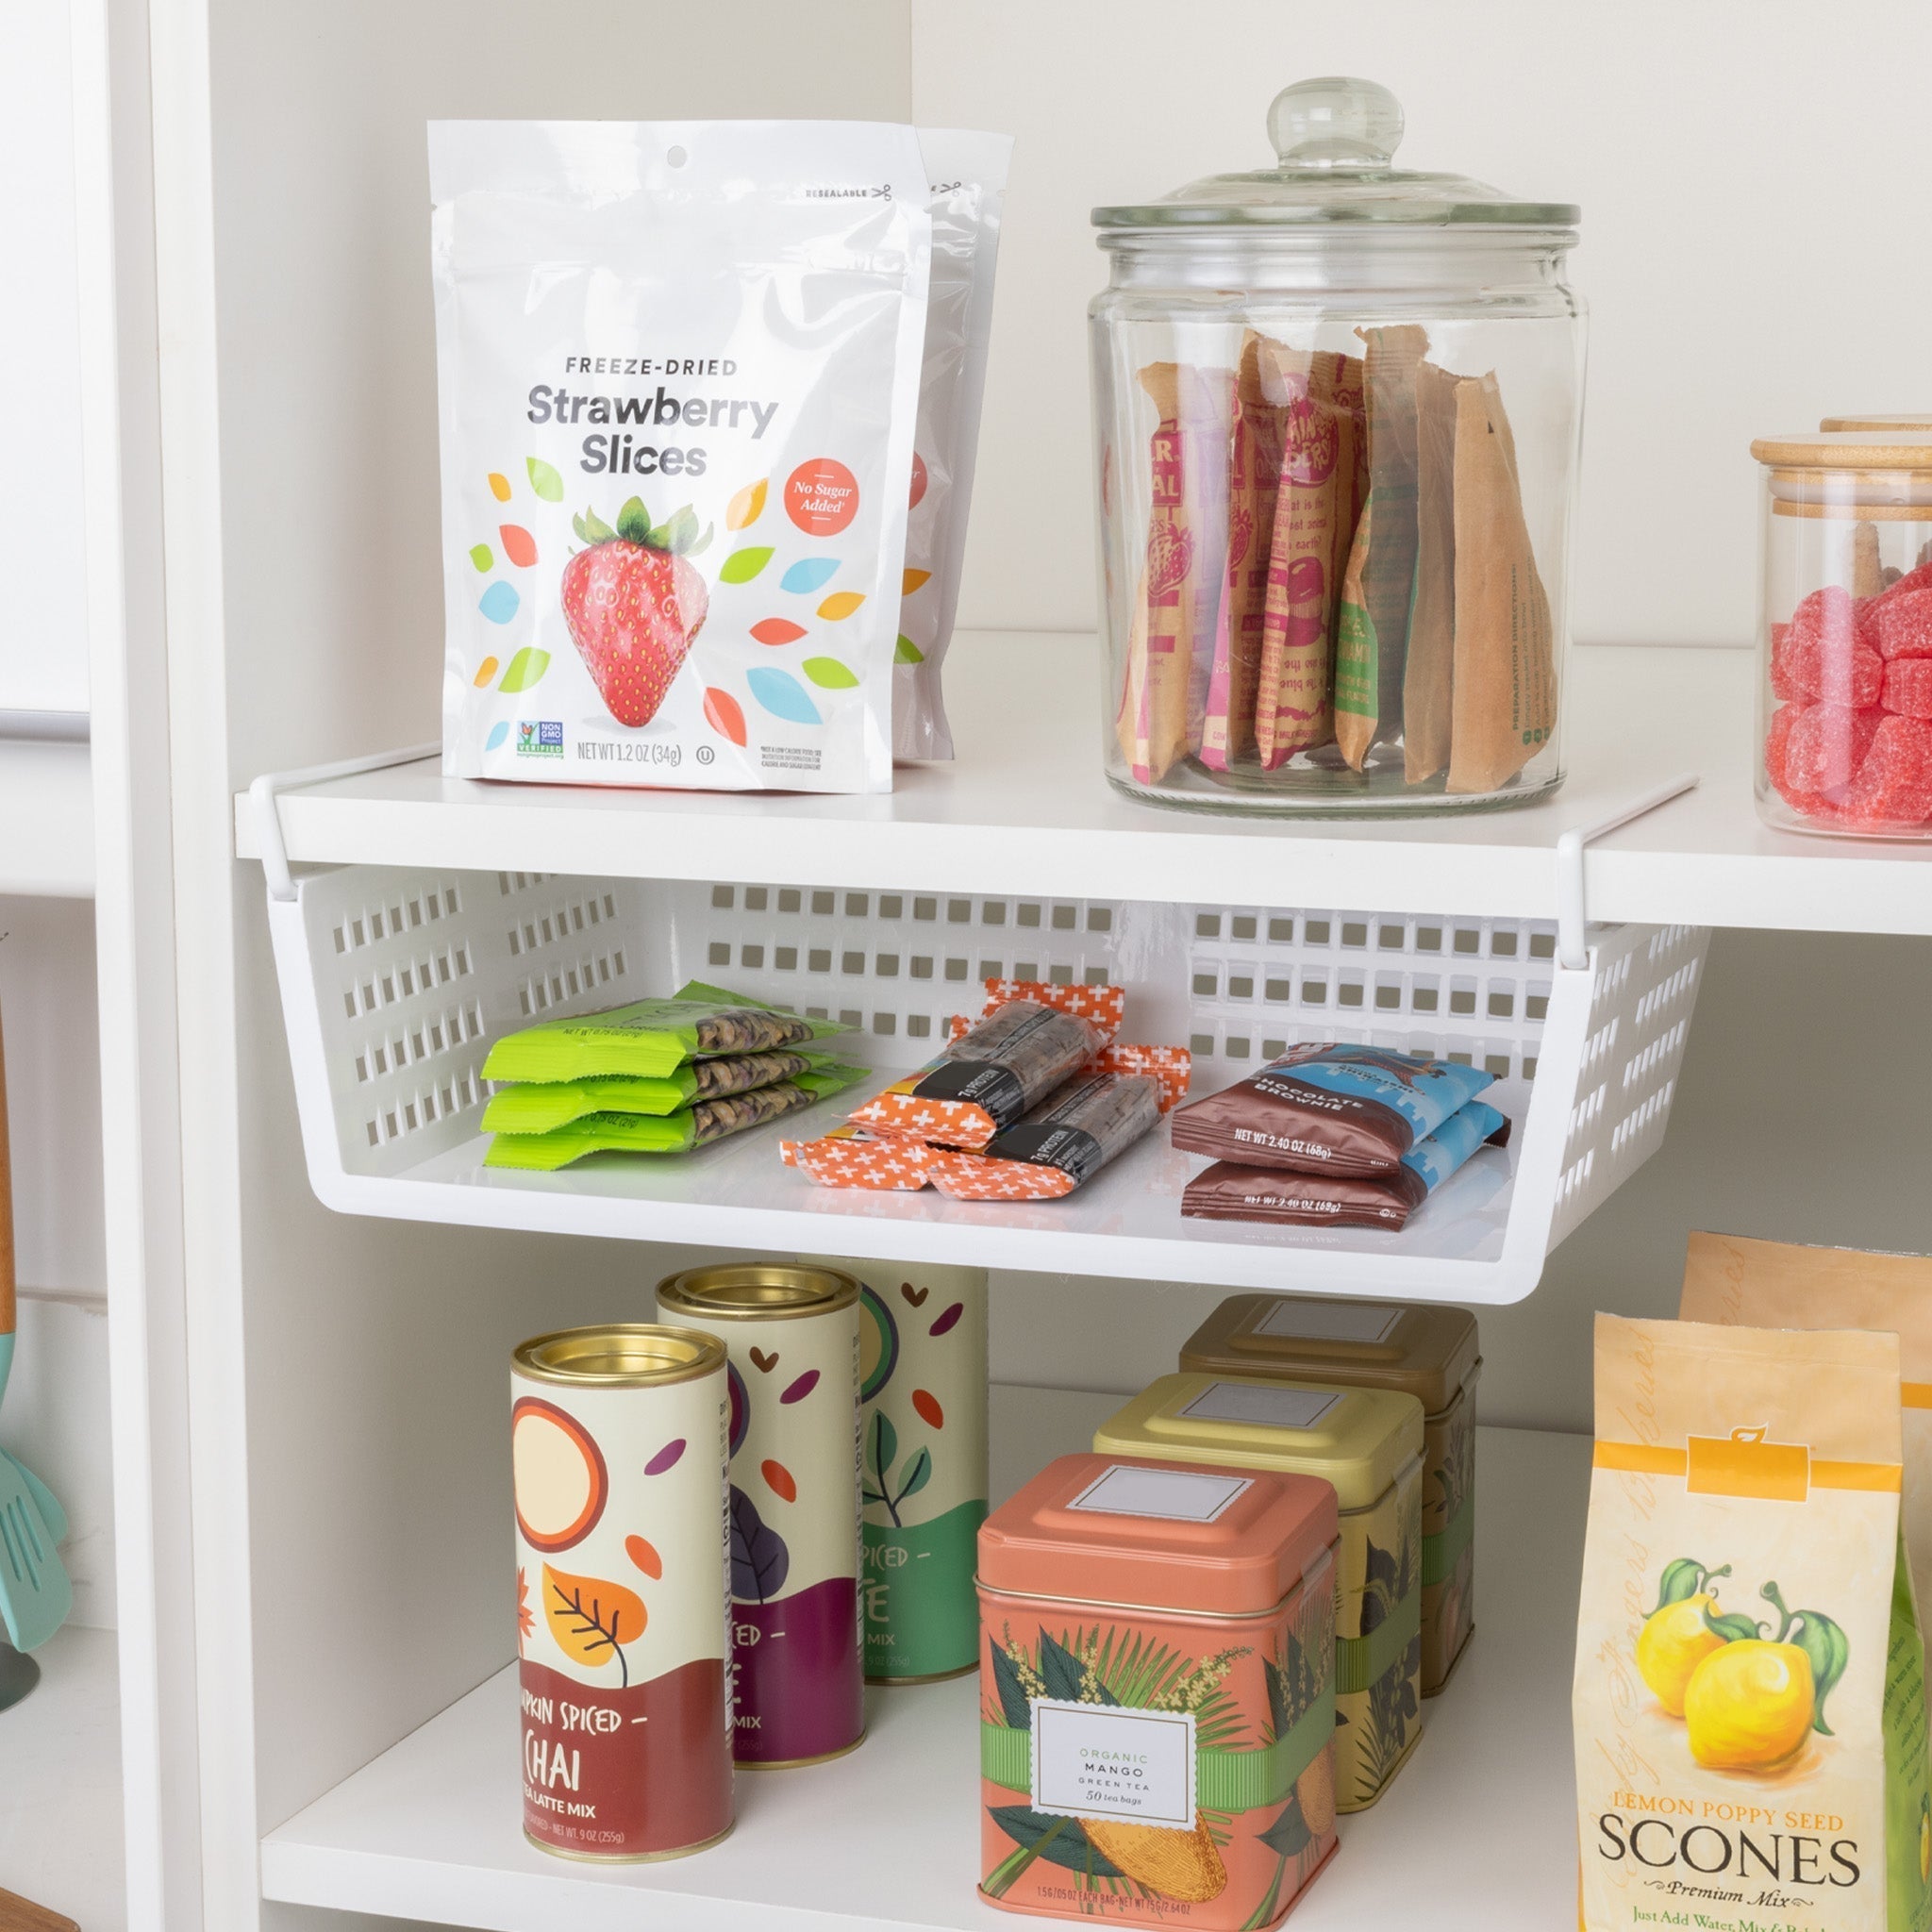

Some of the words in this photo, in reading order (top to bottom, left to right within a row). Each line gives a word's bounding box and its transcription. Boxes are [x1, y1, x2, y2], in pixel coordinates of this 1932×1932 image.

[565, 357, 738, 376] FREEZE-DRIED
[527, 384, 780, 440] Strawberry
[579, 434, 708, 476] Slices
[793, 481, 812, 493] No
[814, 483, 853, 499] Sugar
[1511, 645, 1521, 731] PREPARATION
[519, 744, 562, 753] VERIFIED
[577, 741, 598, 760] NET
[599, 742, 614, 761] WT
[616, 743, 633, 762] 1.2
[637, 744, 650, 762] OZ
[651, 744, 683, 767] (34g)
[1249, 1076, 1364, 1109] CHOCOLATE
[1254, 1083, 1344, 1111] BROWNIE
[1234, 1128, 1253, 1142] NET
[1254, 1131, 1268, 1145] WT
[1269, 1136, 1291, 1151] 2.40
[1291, 1140, 1305, 1154] OZ
[1306, 1143, 1332, 1160] (68g)
[1277, 1198, 1300, 1208] 2.40
[1301, 1199, 1314, 1210] OZ
[1314, 1201, 1341, 1214] (68g)
[862, 1543, 908, 1571] PICED
[868, 1633, 896, 1646] MIX
[559, 1701, 623, 1736] SPICED
[733, 1715, 762, 1729] MIX
[525, 1728, 580, 1791] CHAI
[1079, 1748, 1148, 1764] ORGANIC
[1085, 1762, 1143, 1777] MANGO
[1078, 1777, 1121, 1788] GREEN
[1126, 1782, 1150, 1791] TEA
[533, 1790, 565, 1814] LATTE
[567, 1801, 596, 1819] MIX
[1086, 1790, 1102, 1802] 50
[1104, 1794, 1119, 1803] tea
[1120, 1794, 1142, 1807] bags
[1613, 1791, 1693, 1816] LEMON
[1703, 1802, 1776, 1826] POPPY
[1785, 1811, 1843, 1832] SEED
[552, 1824, 565, 1836] NET
[579, 1829, 585, 1840] 9
[586, 1830, 597, 1841] OZ
[598, 1831, 625, 1844] (255g)
[1599, 1813, 1860, 1888] SCONES
[1666, 1880, 1743, 1904] Premium
[1747, 1890, 1791, 1908] Mix
[1633, 1906, 1657, 1924] Just
[1660, 1909, 1690, 1926] Add
[1693, 1913, 1735, 1932] Water,
